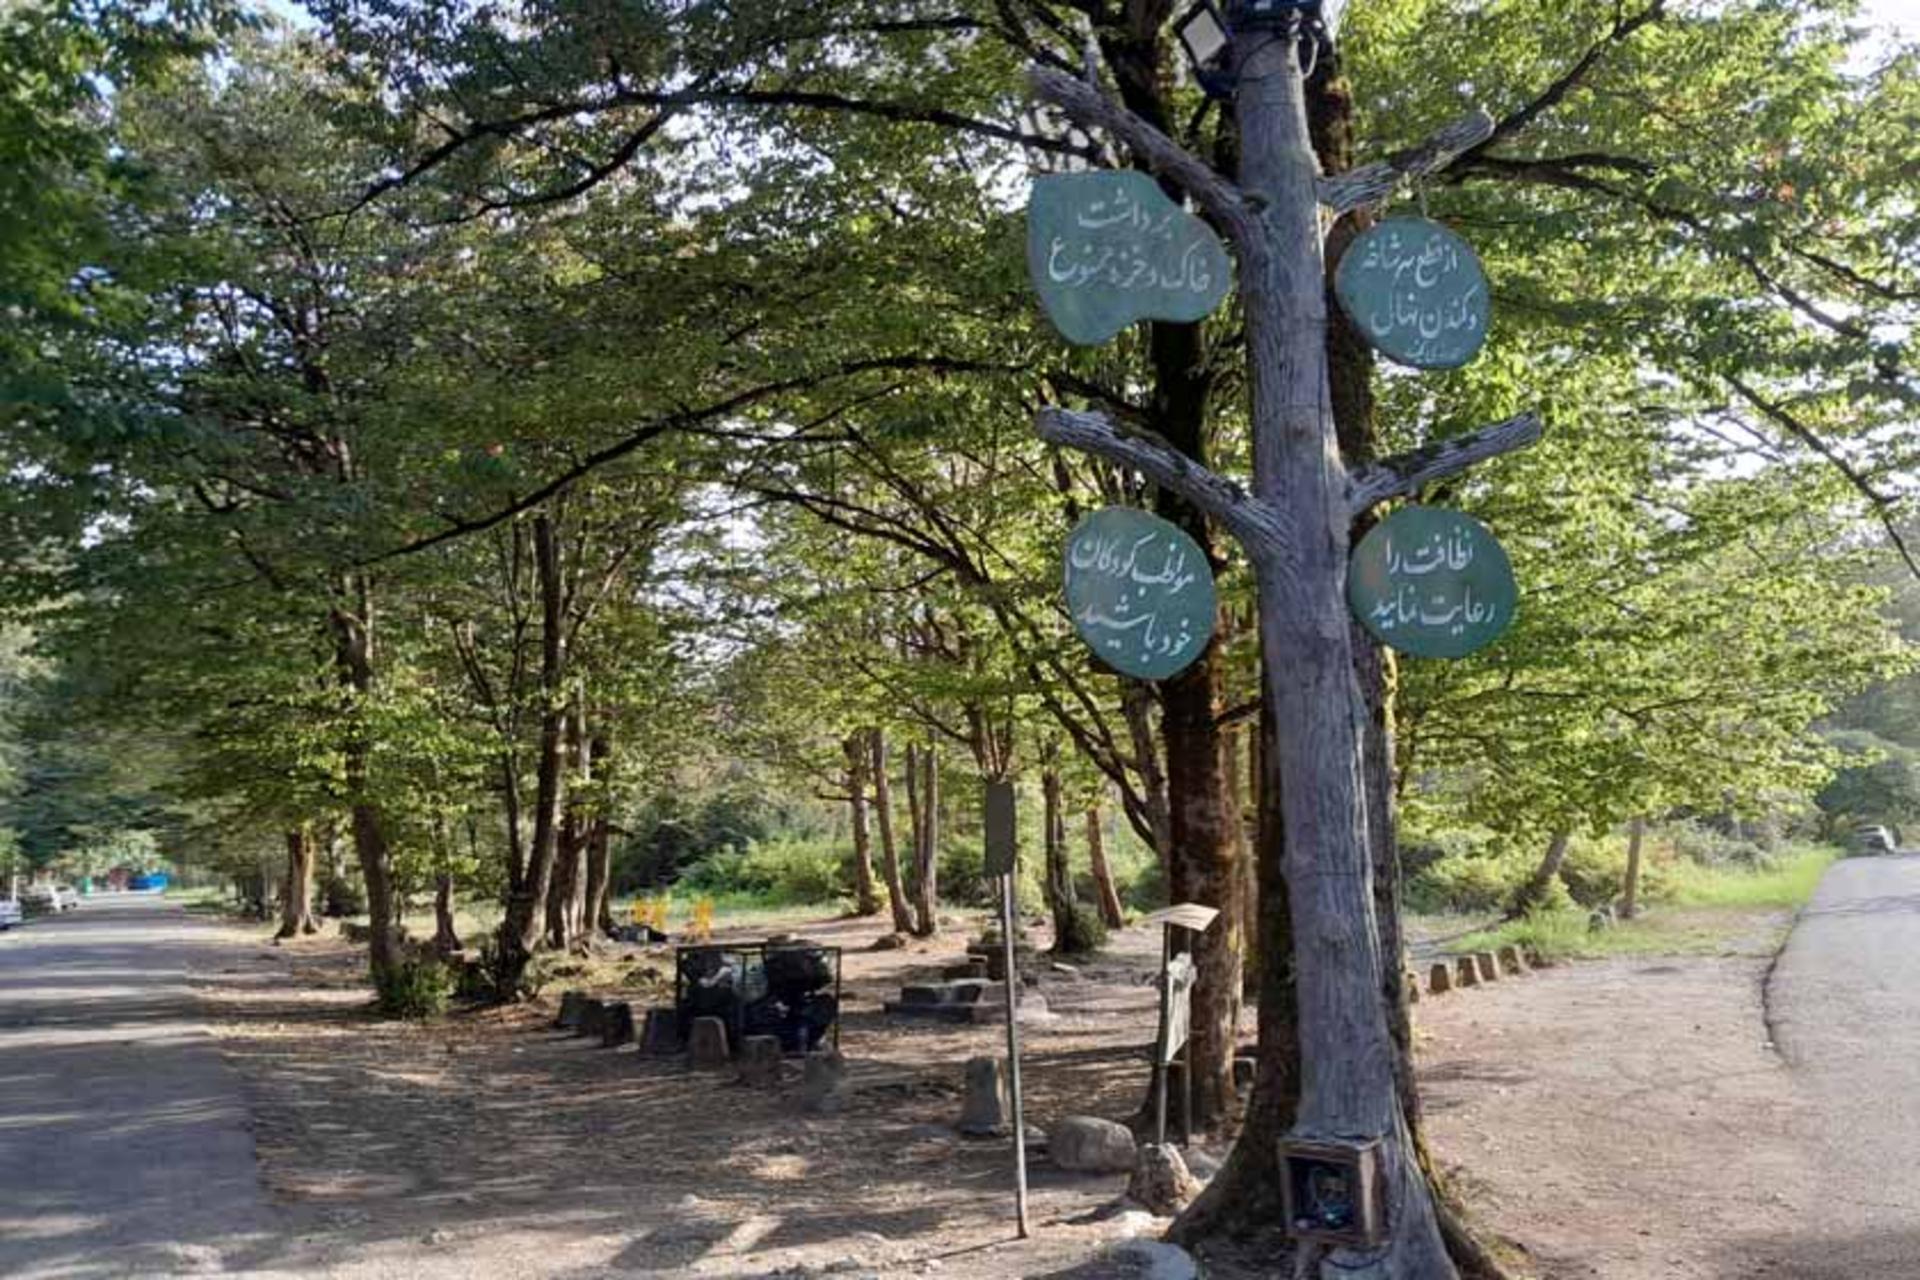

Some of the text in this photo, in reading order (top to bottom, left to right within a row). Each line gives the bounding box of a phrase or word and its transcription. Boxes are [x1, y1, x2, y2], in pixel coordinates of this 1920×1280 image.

[1071, 530, 1195, 597] مواظب کودکان
[1386, 526, 1473, 575] نظافت را
[1076, 594, 1192, 663] خود باشید
[1420, 585, 1496, 635] رعایت
